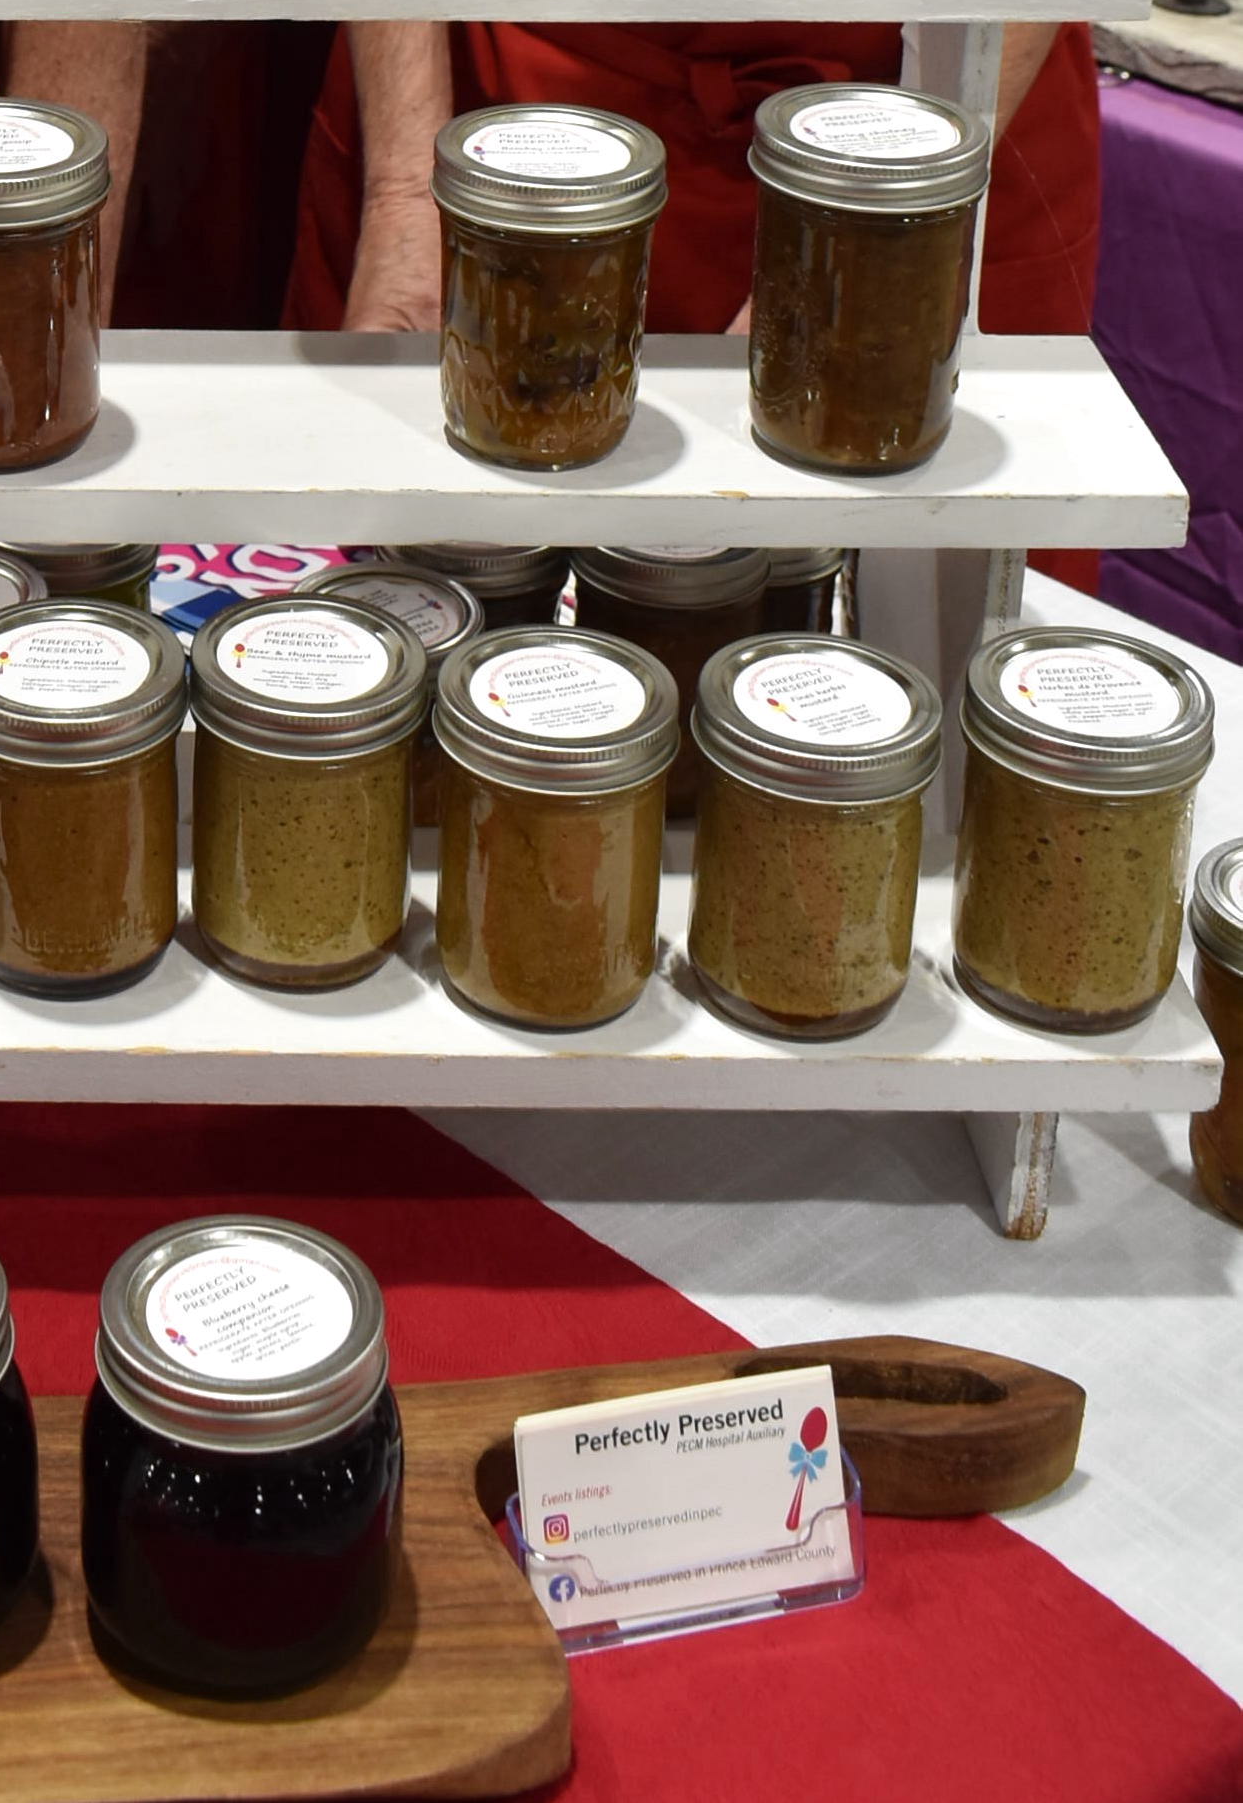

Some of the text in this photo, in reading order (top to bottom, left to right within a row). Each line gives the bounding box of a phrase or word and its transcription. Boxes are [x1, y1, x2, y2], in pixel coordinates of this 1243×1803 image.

[31, 638, 104, 647] PERFECTLY
[263, 639, 339, 647] PRESERVED
[265, 630, 338, 640] PERFECTLY
[28, 646, 104, 655] PRESERVED
[504, 662, 573, 679] PERFECTLY
[509, 671, 579, 687] PRESERVED
[760, 668, 823, 689] PERFECTLY
[1037, 666, 1107, 675] PERFECTLY
[1040, 674, 1114, 683] PRESERVED
[768, 675, 833, 696] PRESERVED
[173, 1265, 246, 1302] PERFECTLY
[182, 1275, 257, 1313] PRESERVED
[202, 1283, 291, 1327] Blueberry cheese
[216, 1304, 273, 1334] companion
[575, 1398, 784, 1454] Perfectly Preserved
[676, 1426, 786, 1454] PECM Hospital Auxiliary
[541, 1492, 573, 1507] Events
[574, 1506, 722, 1543] perfectlypreservedinpec
[634, 1569, 691, 1589] Preserved
[694, 1567, 706, 1580] in
[709, 1560, 747, 1578] Prince
[750, 1552, 792, 1570] Edward
[796, 1545, 836, 1562] County
